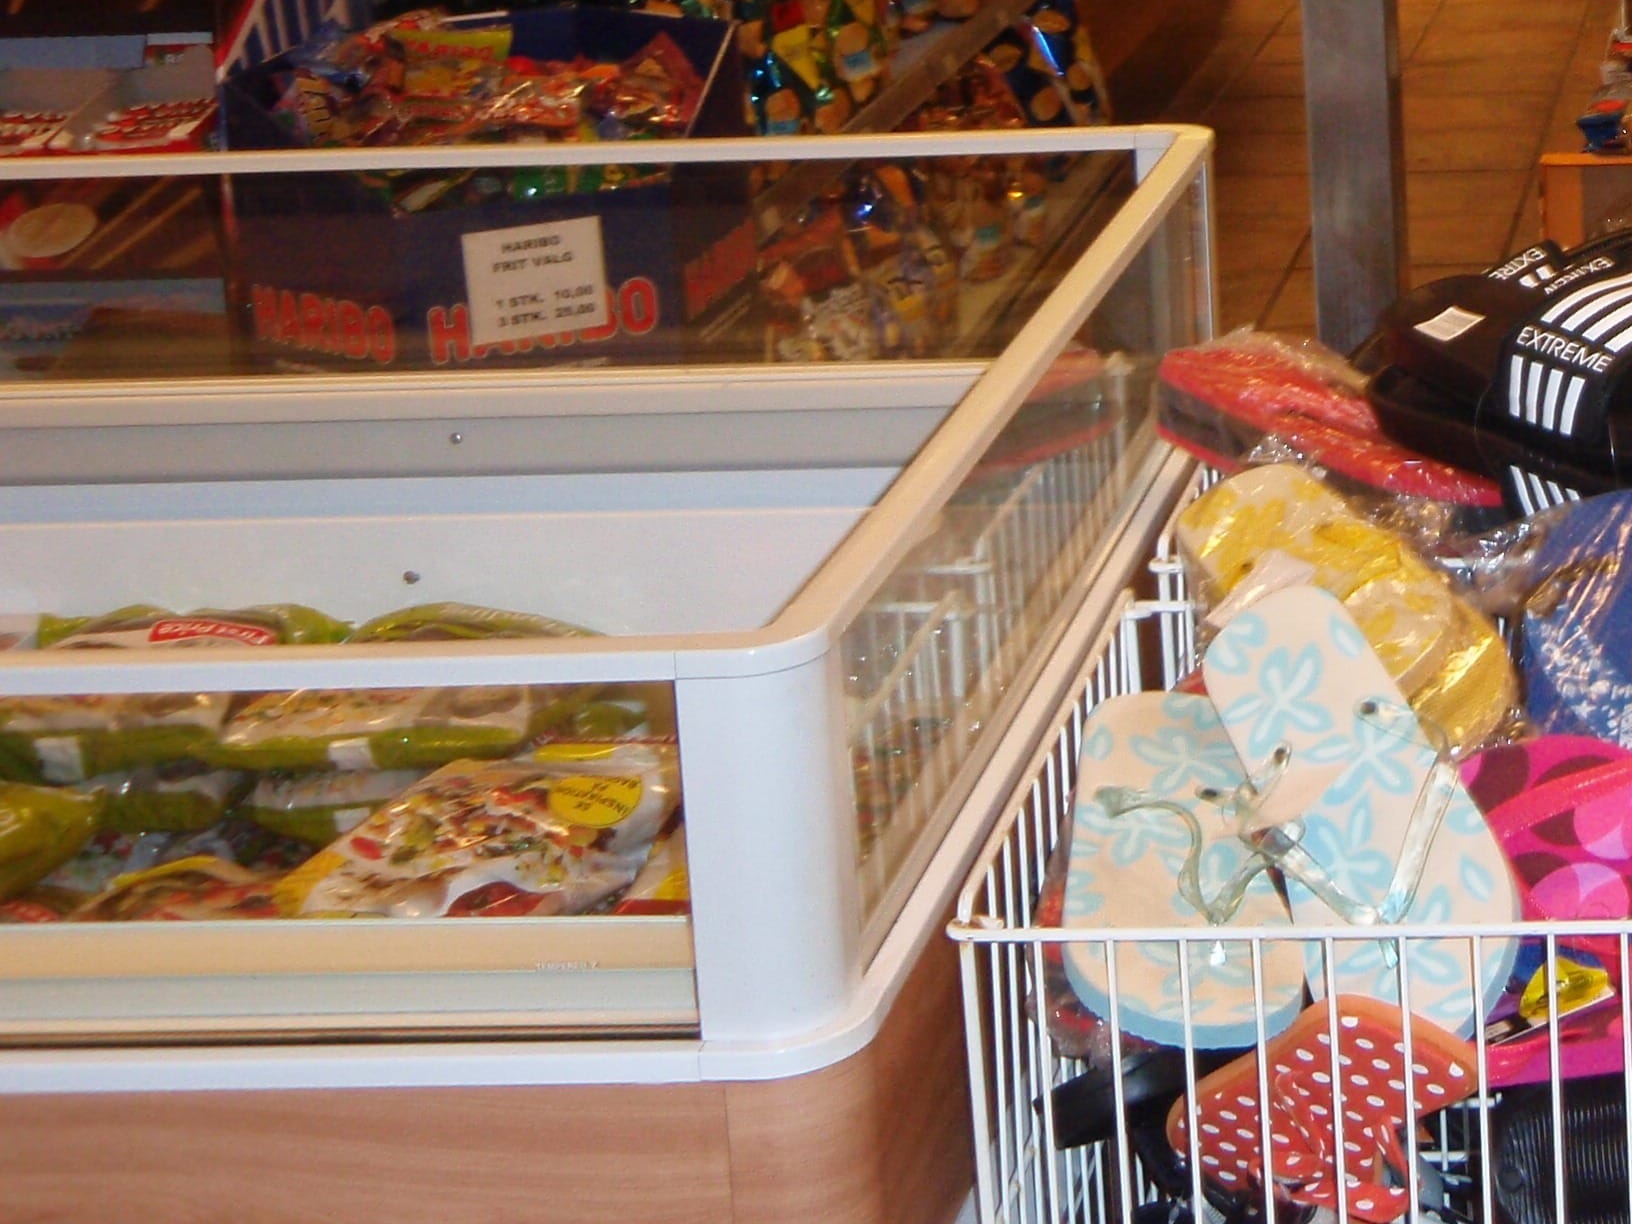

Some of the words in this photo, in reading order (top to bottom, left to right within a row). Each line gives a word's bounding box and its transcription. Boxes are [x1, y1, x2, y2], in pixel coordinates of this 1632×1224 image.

[492, 258, 528, 274] FRIT
[531, 250, 575, 268] VALG
[502, 234, 562, 254] HARIBO
[252, 284, 396, 365] HARIBO
[1516, 326, 1616, 374] EXTREME
